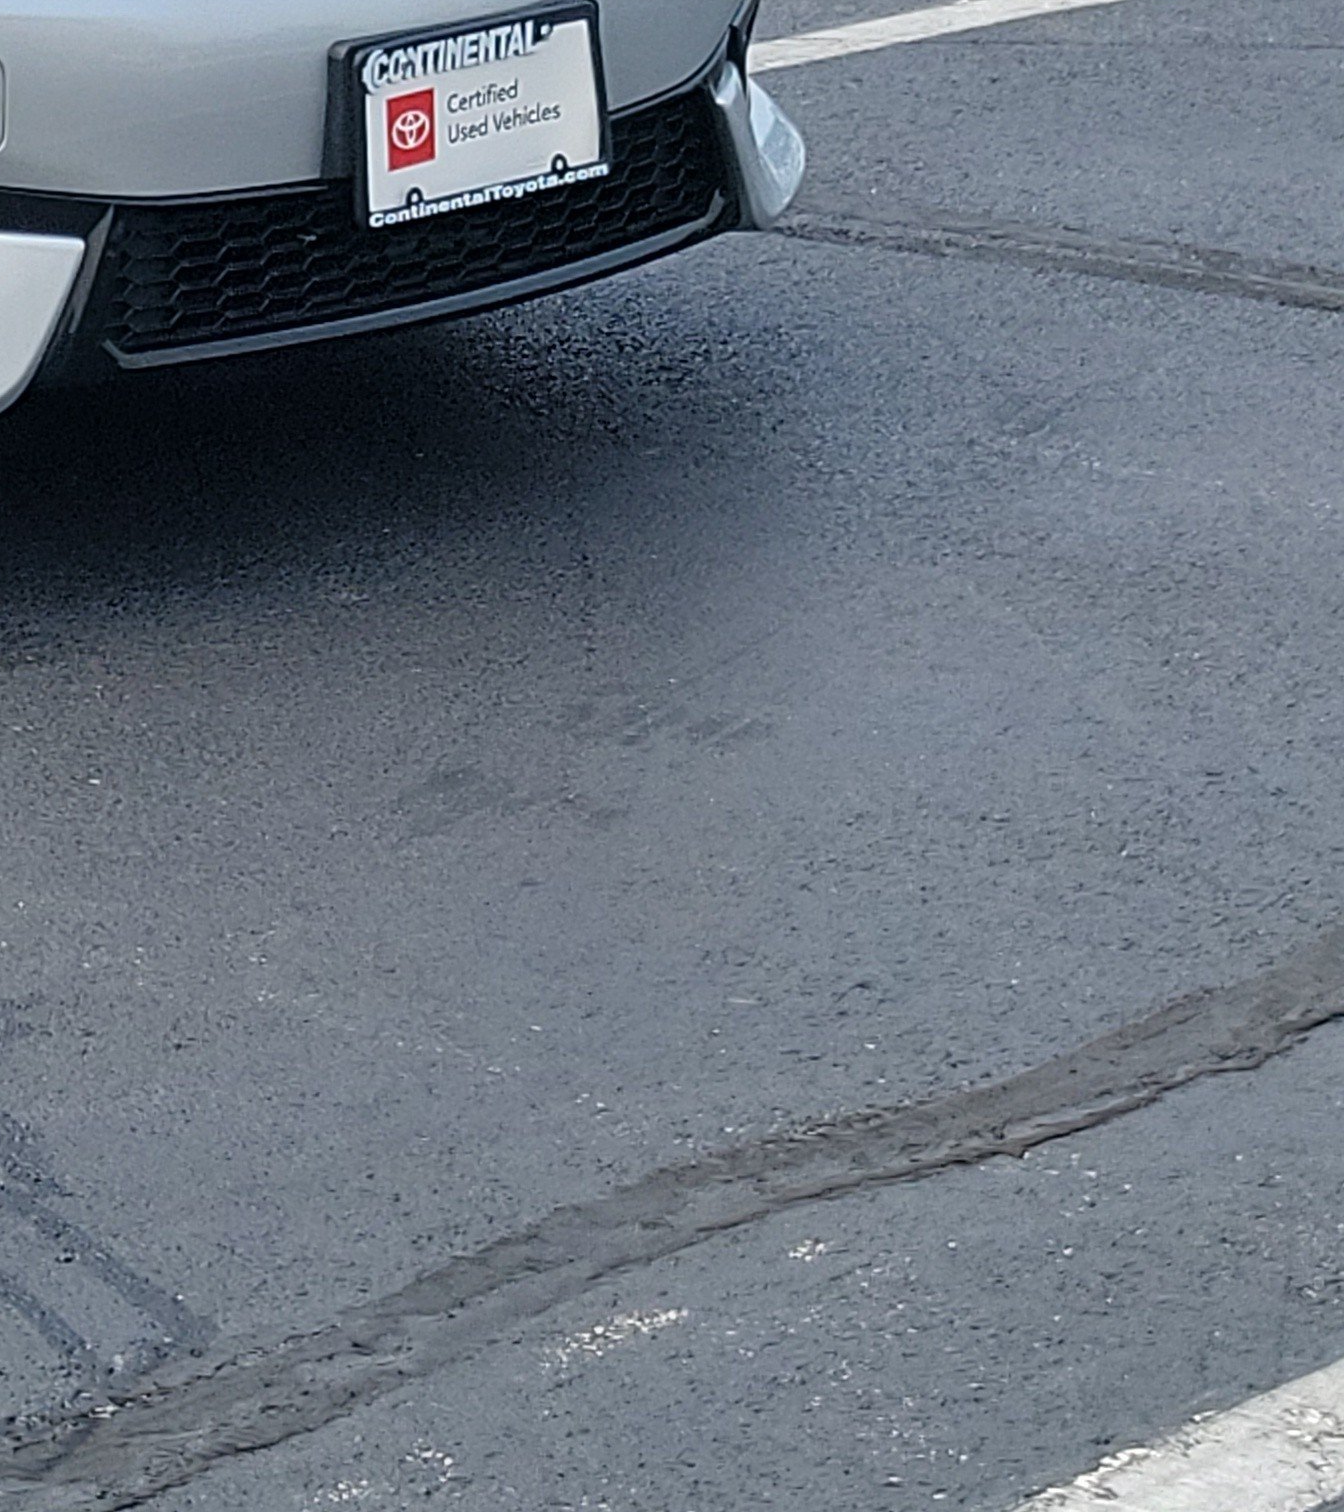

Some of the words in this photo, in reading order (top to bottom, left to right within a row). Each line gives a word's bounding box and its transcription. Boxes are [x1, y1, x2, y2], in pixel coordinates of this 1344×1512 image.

[363, 20, 537, 92] CONTINENTAL
[447, 79, 519, 113] Certified
[448, 114, 488, 144] Used
[493, 102, 562, 132] Vehicles
[369, 163, 609, 228] ContinentalToyota.com
